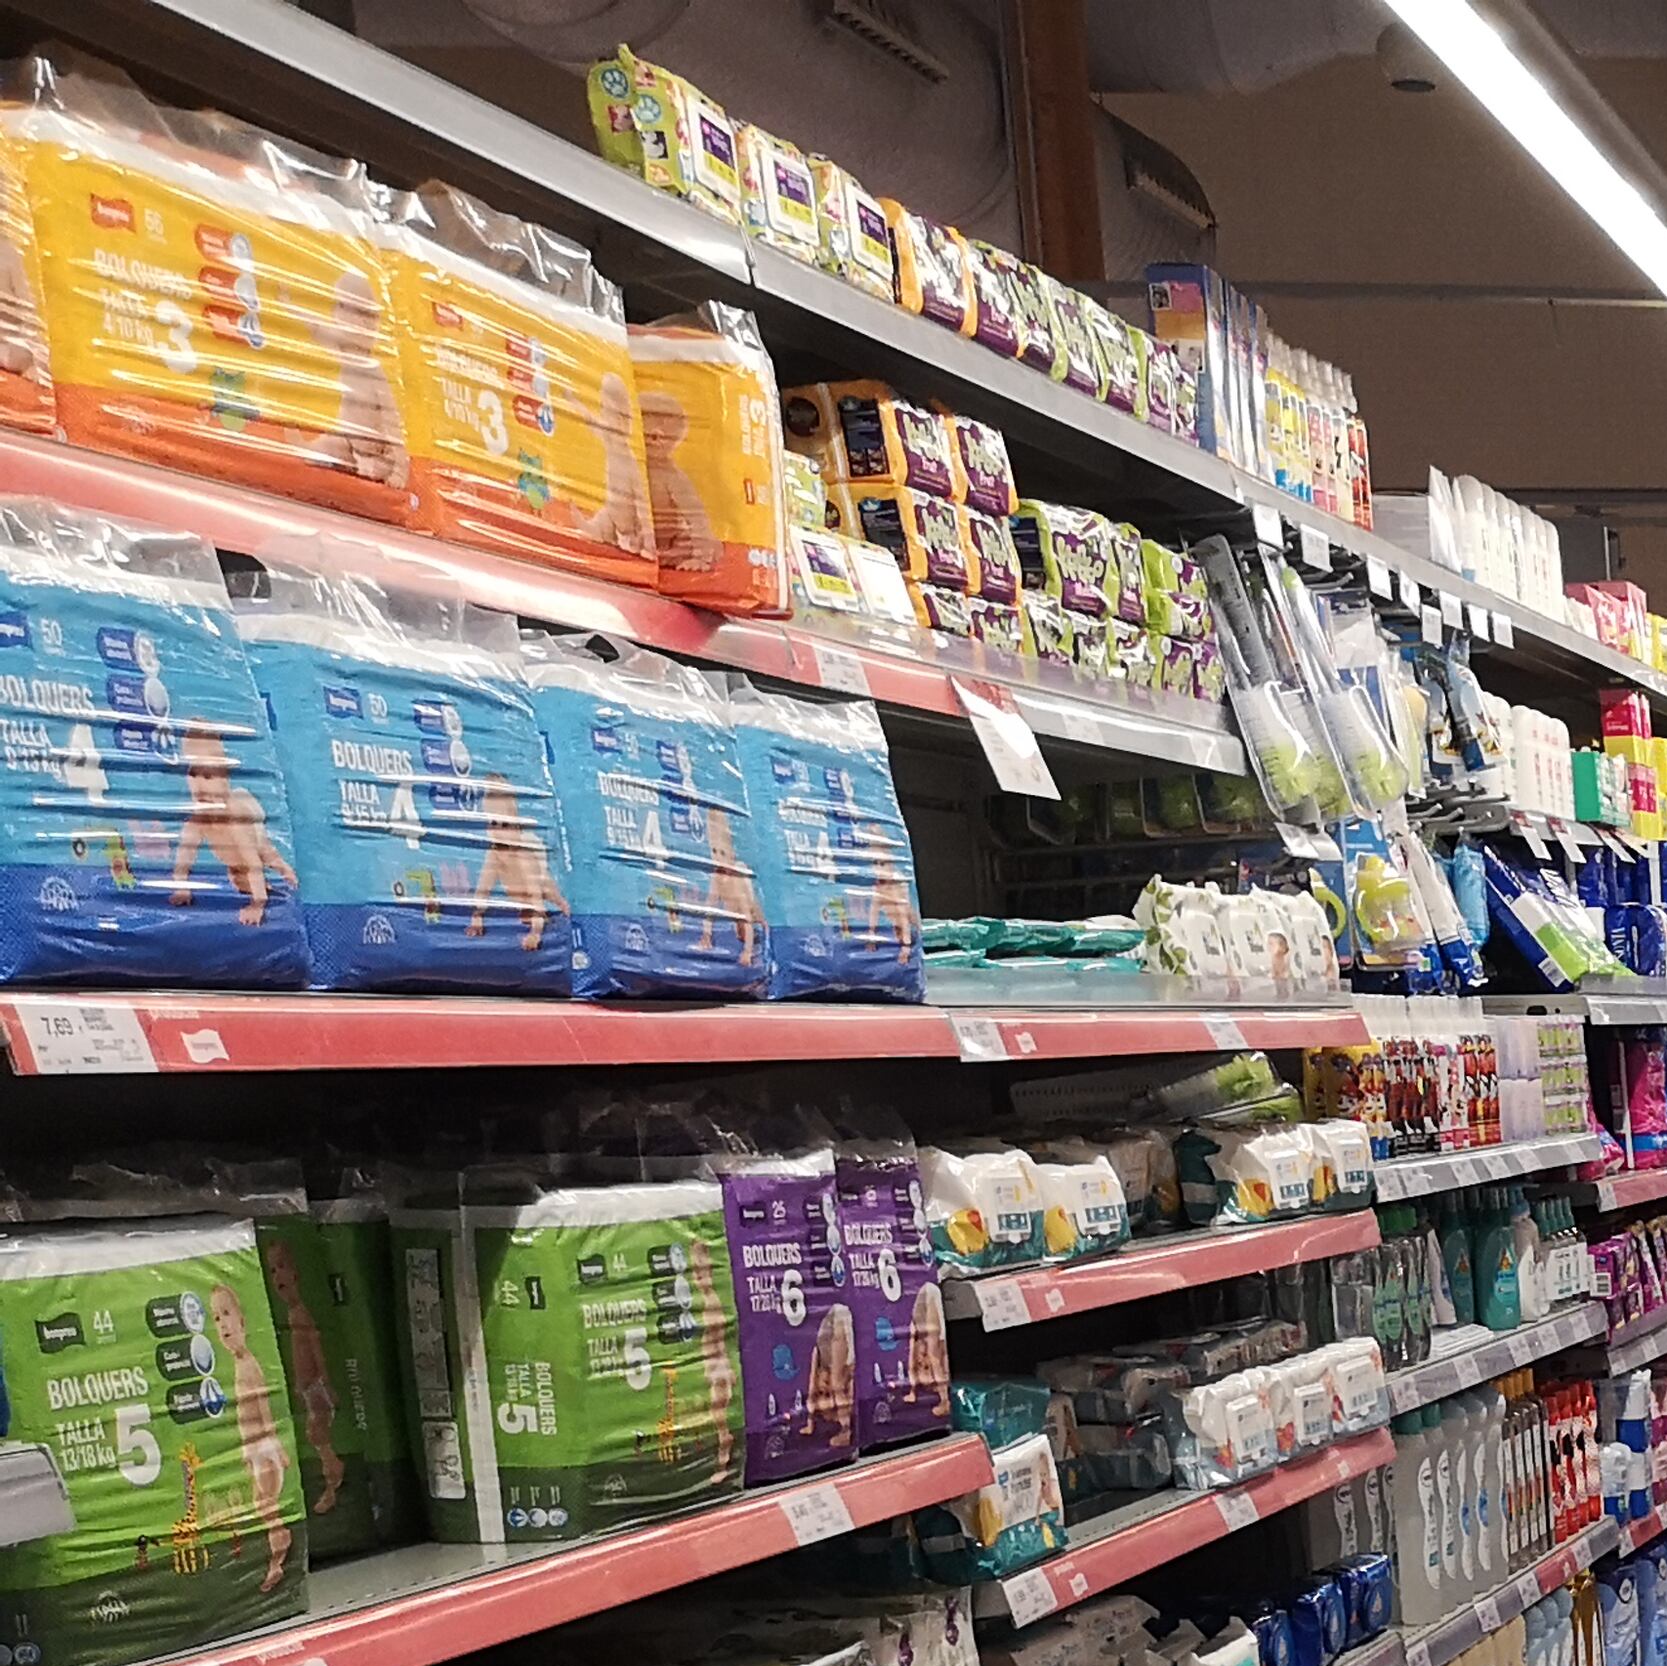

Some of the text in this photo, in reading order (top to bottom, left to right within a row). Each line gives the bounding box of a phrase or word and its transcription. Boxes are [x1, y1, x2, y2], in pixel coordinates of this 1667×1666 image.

[155, 300, 197, 373] 3
[478, 390, 508, 455] 3
[65, 725, 109, 802] 4
[331, 740, 414, 775] BOLQUERS
[340, 781, 380, 805] TALLA
[391, 784, 422, 849] 4
[41, 1017, 73, 1037] 7,69
[742, 1243, 802, 1268] BOLQUERS
[878, 1248, 902, 1302] 6
[747, 1275, 777, 1294] TALLA
[781, 1269, 807, 1327] 6
[92, 1309, 114, 1333] 44
[582, 1299, 647, 1328] BOLQUERS
[624, 1326, 652, 1391] 5
[47, 1366, 149, 1410] BOLQUERS
[535, 1362, 557, 1436] BOLQUERS
[55, 1418, 105, 1446] TALLA
[498, 1402, 538, 1434] 5
[60, 1443, 116, 1472] 13/18 kg
[115, 1402, 161, 1487] 5
